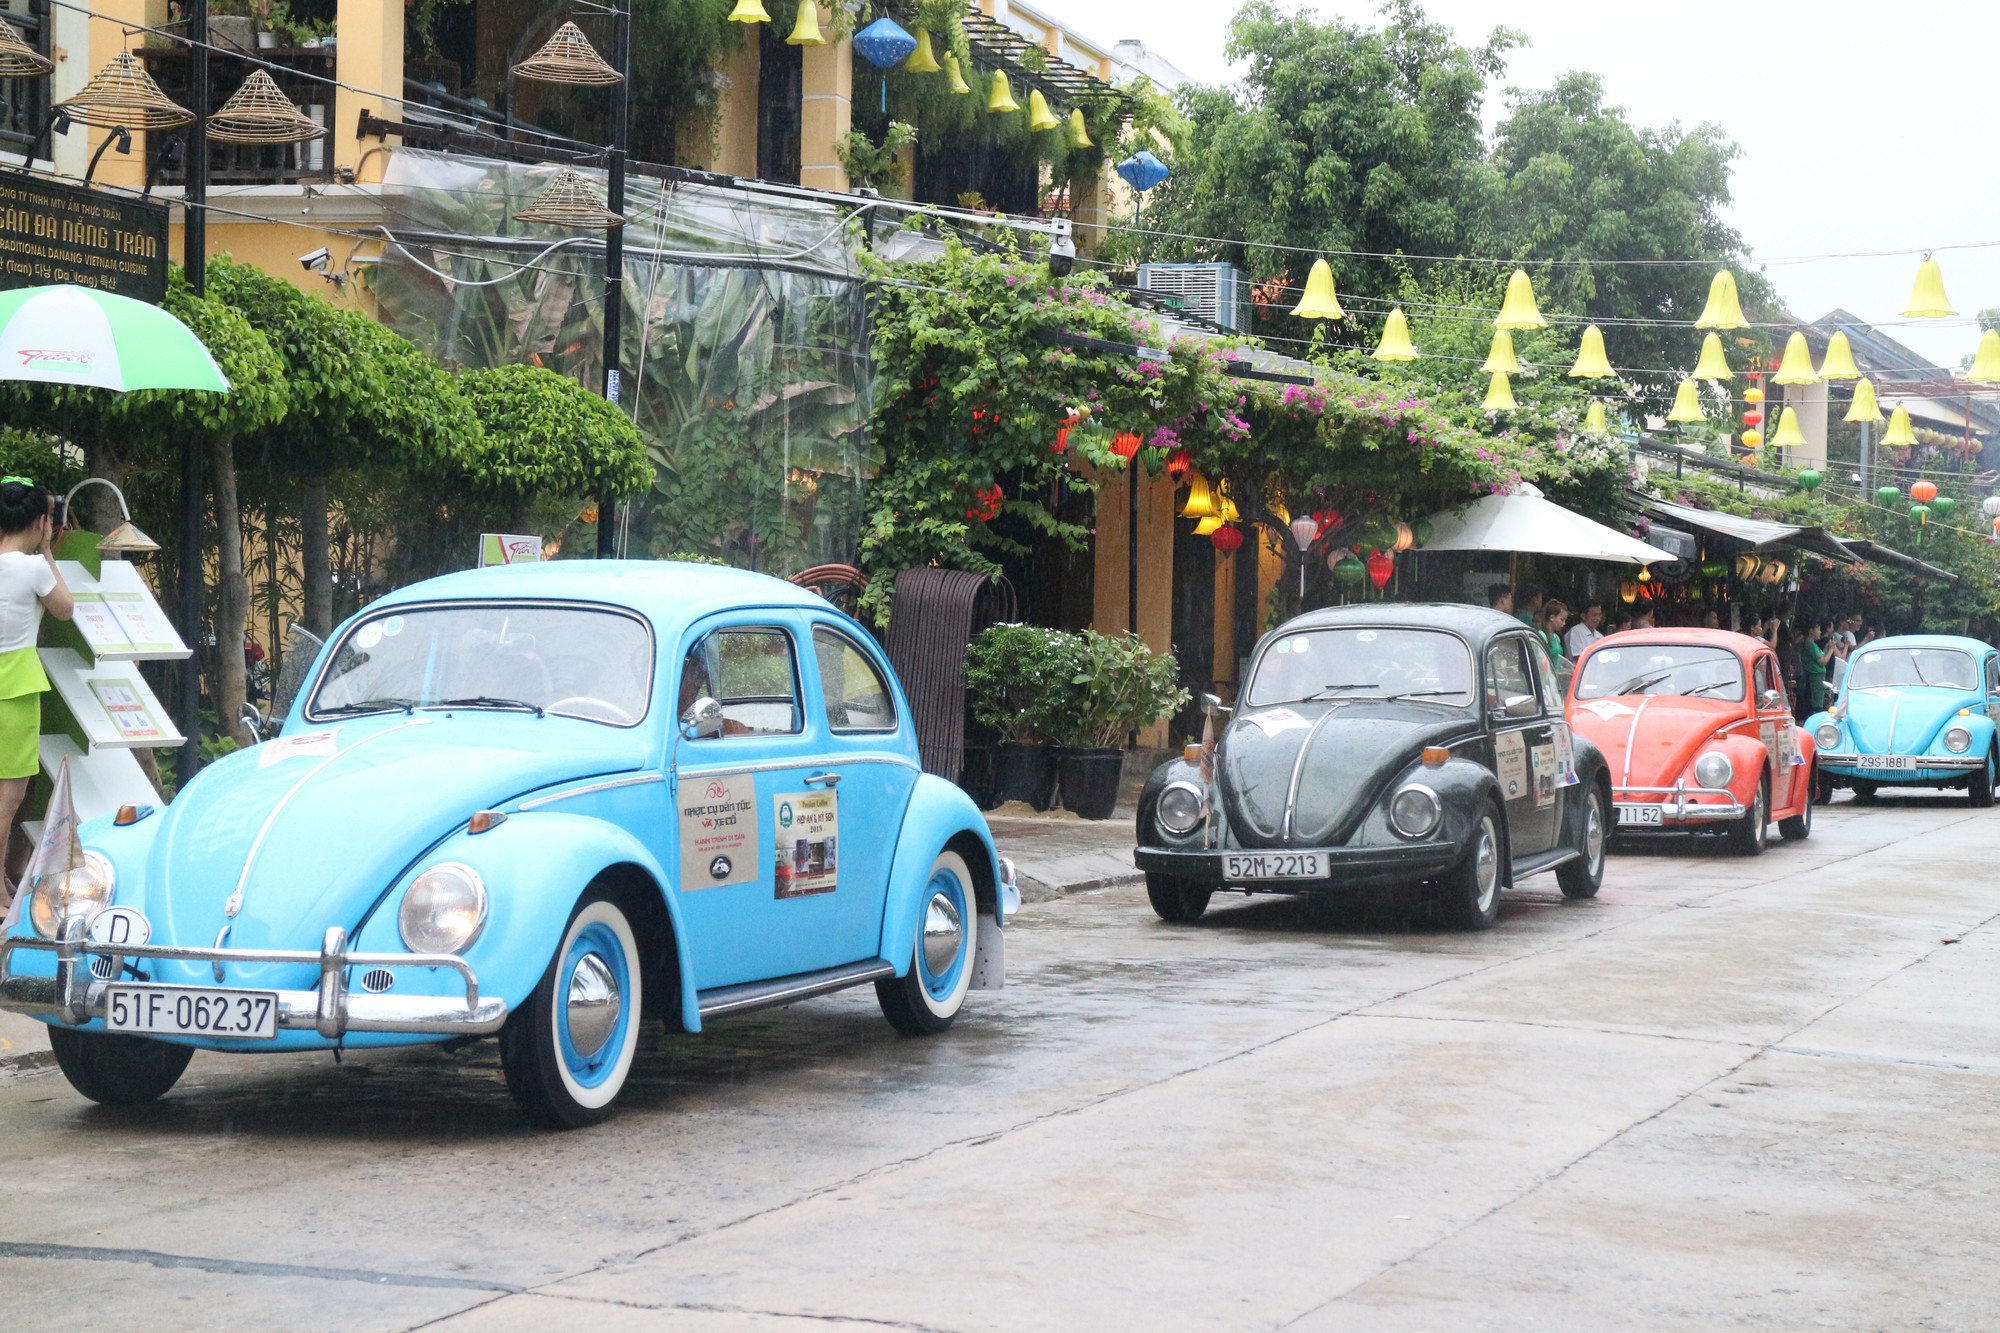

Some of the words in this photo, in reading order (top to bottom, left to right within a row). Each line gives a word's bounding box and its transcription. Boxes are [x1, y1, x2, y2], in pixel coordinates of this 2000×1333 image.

[18, 191, 27, 201] TY
[29, 192, 49, 206] TNHH
[50, 198, 66, 210] MTV
[34, 212, 57, 239] ĐÀ
[6, 259, 33, 277] (Tran)
[54, 268, 70, 281] (Da
[48, 247, 82, 263] DANANG
[84, 253, 117, 270] VIETNAM
[118, 260, 148, 276] CUISINE
[1861, 756, 1906, 768] 29S-1881
[1229, 855, 1317, 877] 52M-2213
[109, 914, 130, 943] D
[112, 992, 271, 1033] 51F-062.37
